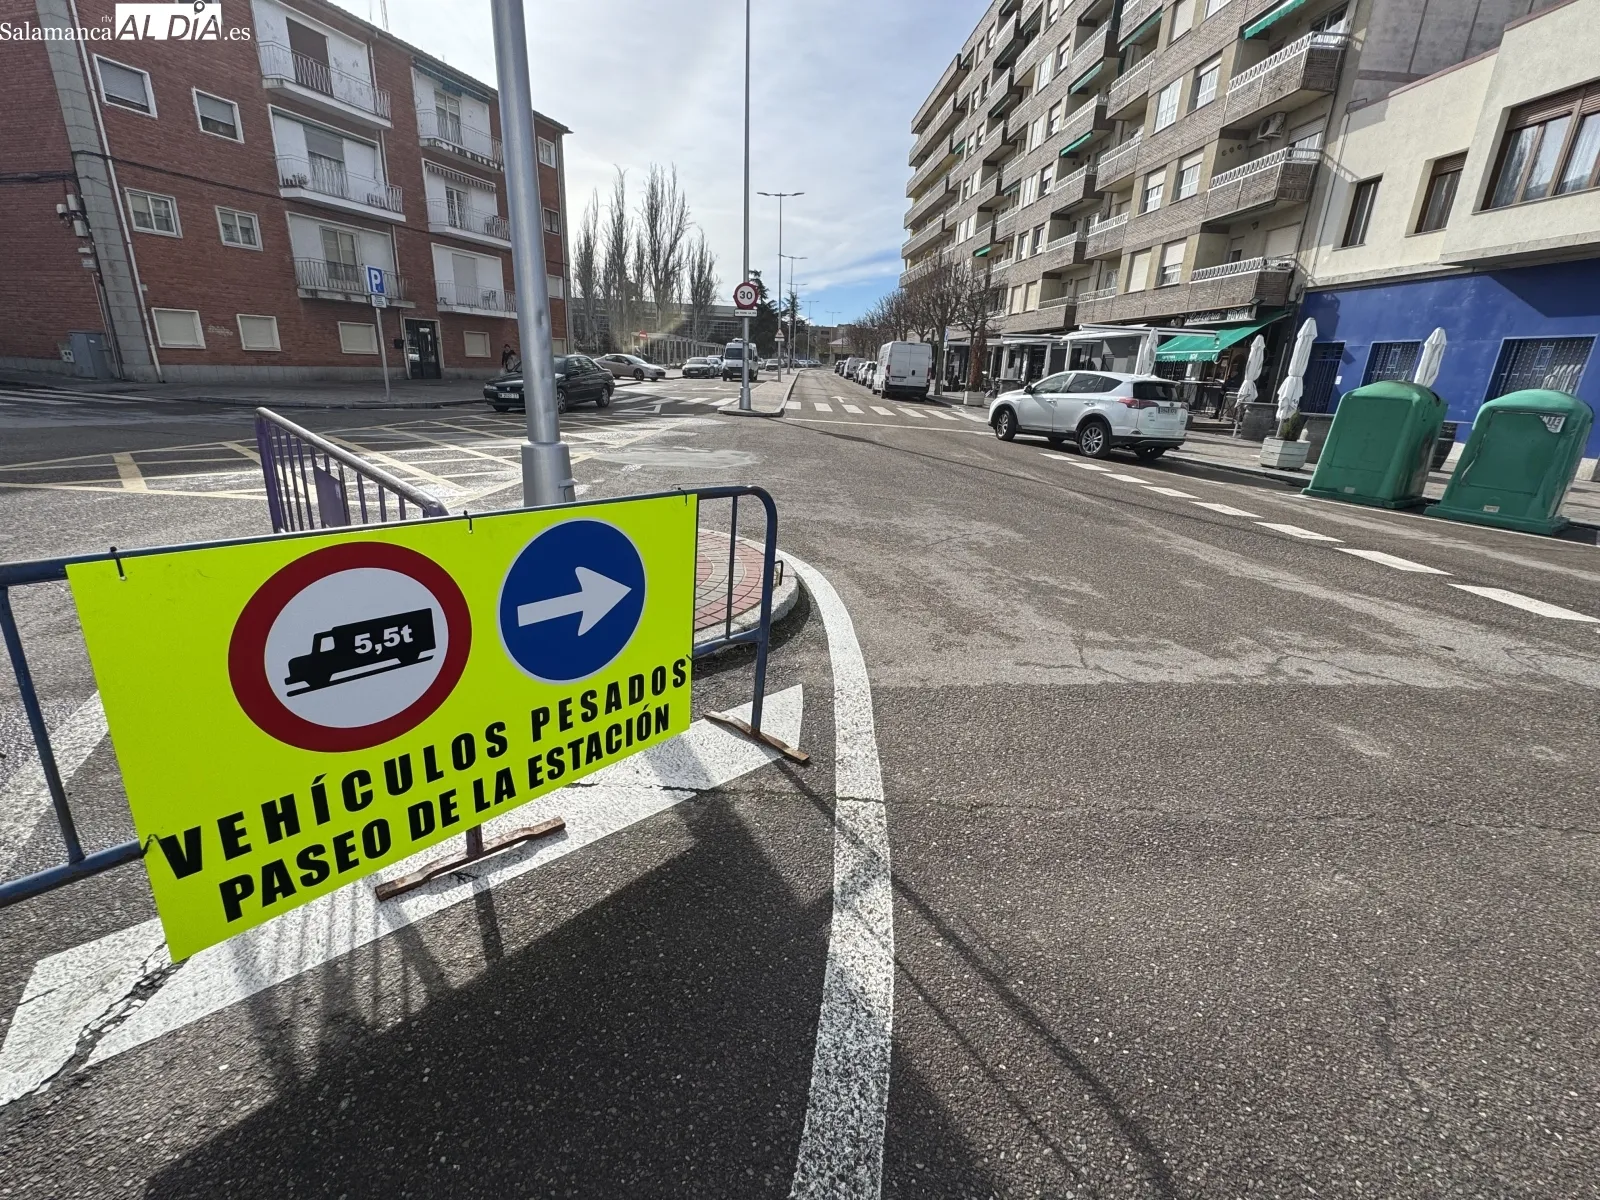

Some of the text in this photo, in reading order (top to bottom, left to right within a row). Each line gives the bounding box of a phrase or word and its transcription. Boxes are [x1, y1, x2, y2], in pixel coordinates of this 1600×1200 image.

[370, 269, 381, 293] P
[739, 290, 753, 300] 30
[354, 624, 414, 655] 5,5t
[159, 658, 687, 881] VEHÍCULOS PESADOS
[218, 703, 670, 923] PASEO DE LA ESTACIÓN
